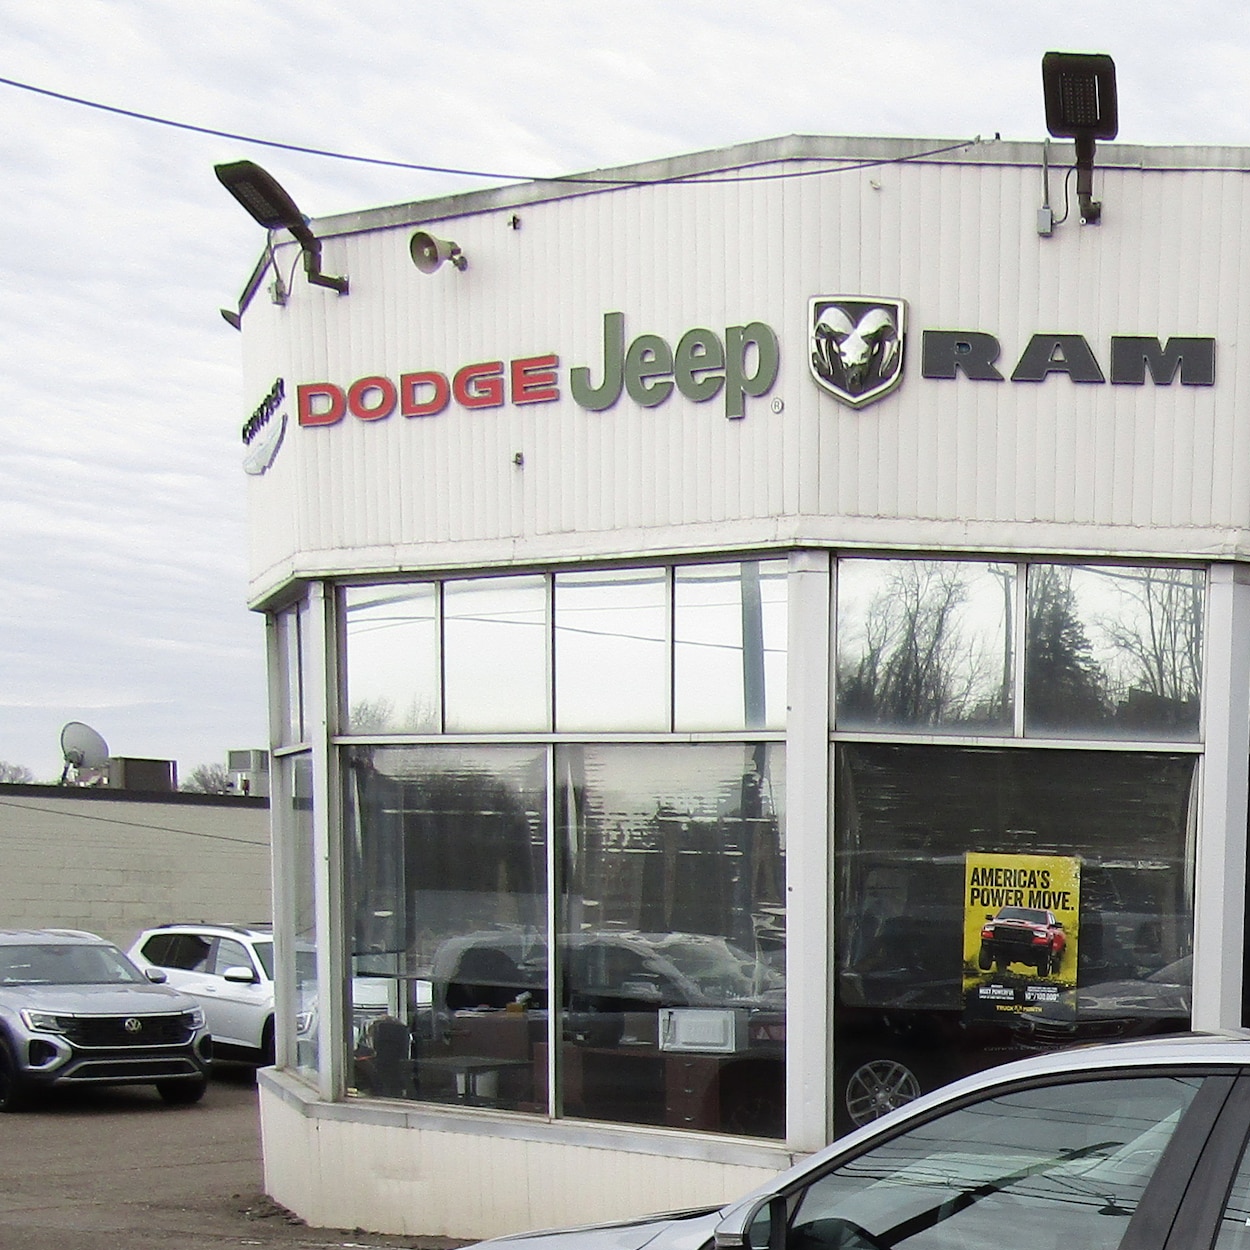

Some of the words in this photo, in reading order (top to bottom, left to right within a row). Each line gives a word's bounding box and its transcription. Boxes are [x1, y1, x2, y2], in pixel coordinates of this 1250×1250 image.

[571, 312, 779, 420] Jeep
[922, 329, 1217, 386] RAM
[297, 354, 559, 427] DODGE
[970, 867, 1050, 889] AMERICA'S
[970, 888, 1023, 908] POWER
[1028, 890, 1075, 911] MOVE.
